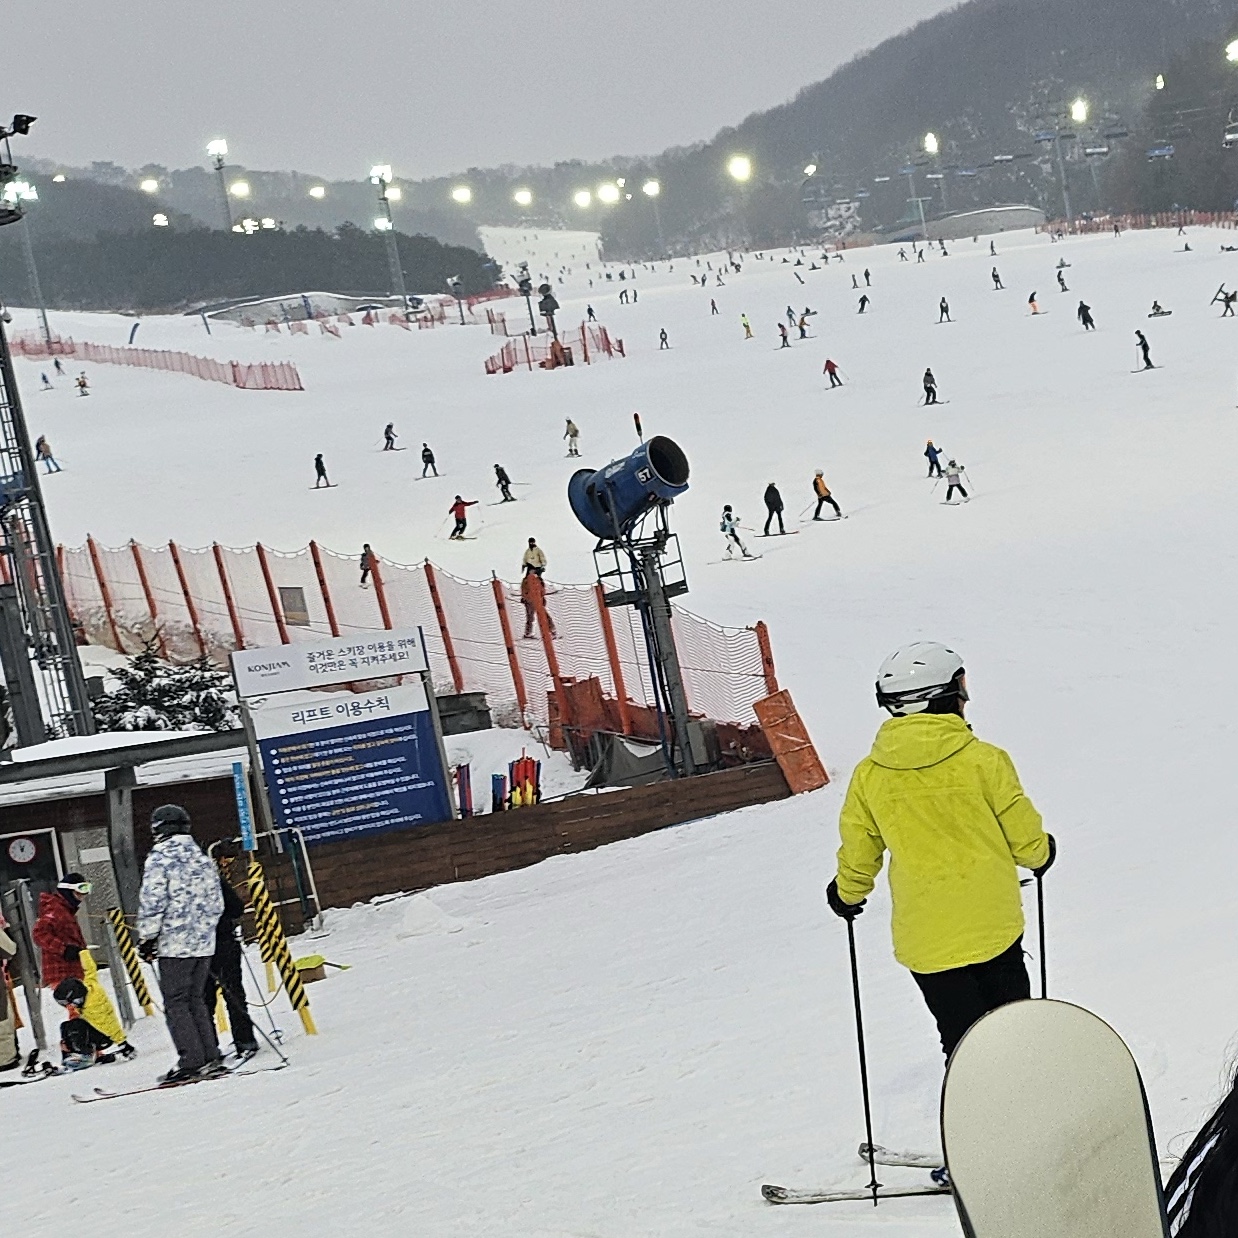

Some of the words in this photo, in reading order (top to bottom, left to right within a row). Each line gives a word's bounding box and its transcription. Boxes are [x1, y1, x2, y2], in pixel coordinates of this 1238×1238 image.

[637, 468, 651, 482] 57
[306, 650, 335, 663] 즐거운
[337, 645, 365, 656] 스키장
[367, 641, 395, 653] 이용을
[397, 638, 417, 649] 위해
[308, 660, 347, 674] 이것만은
[348, 657, 358, 669] 꼭
[360, 651, 410, 667] 지켜주세요!
[291, 706, 334, 725] 리프트
[335, 696, 391, 718] 이용수칙
